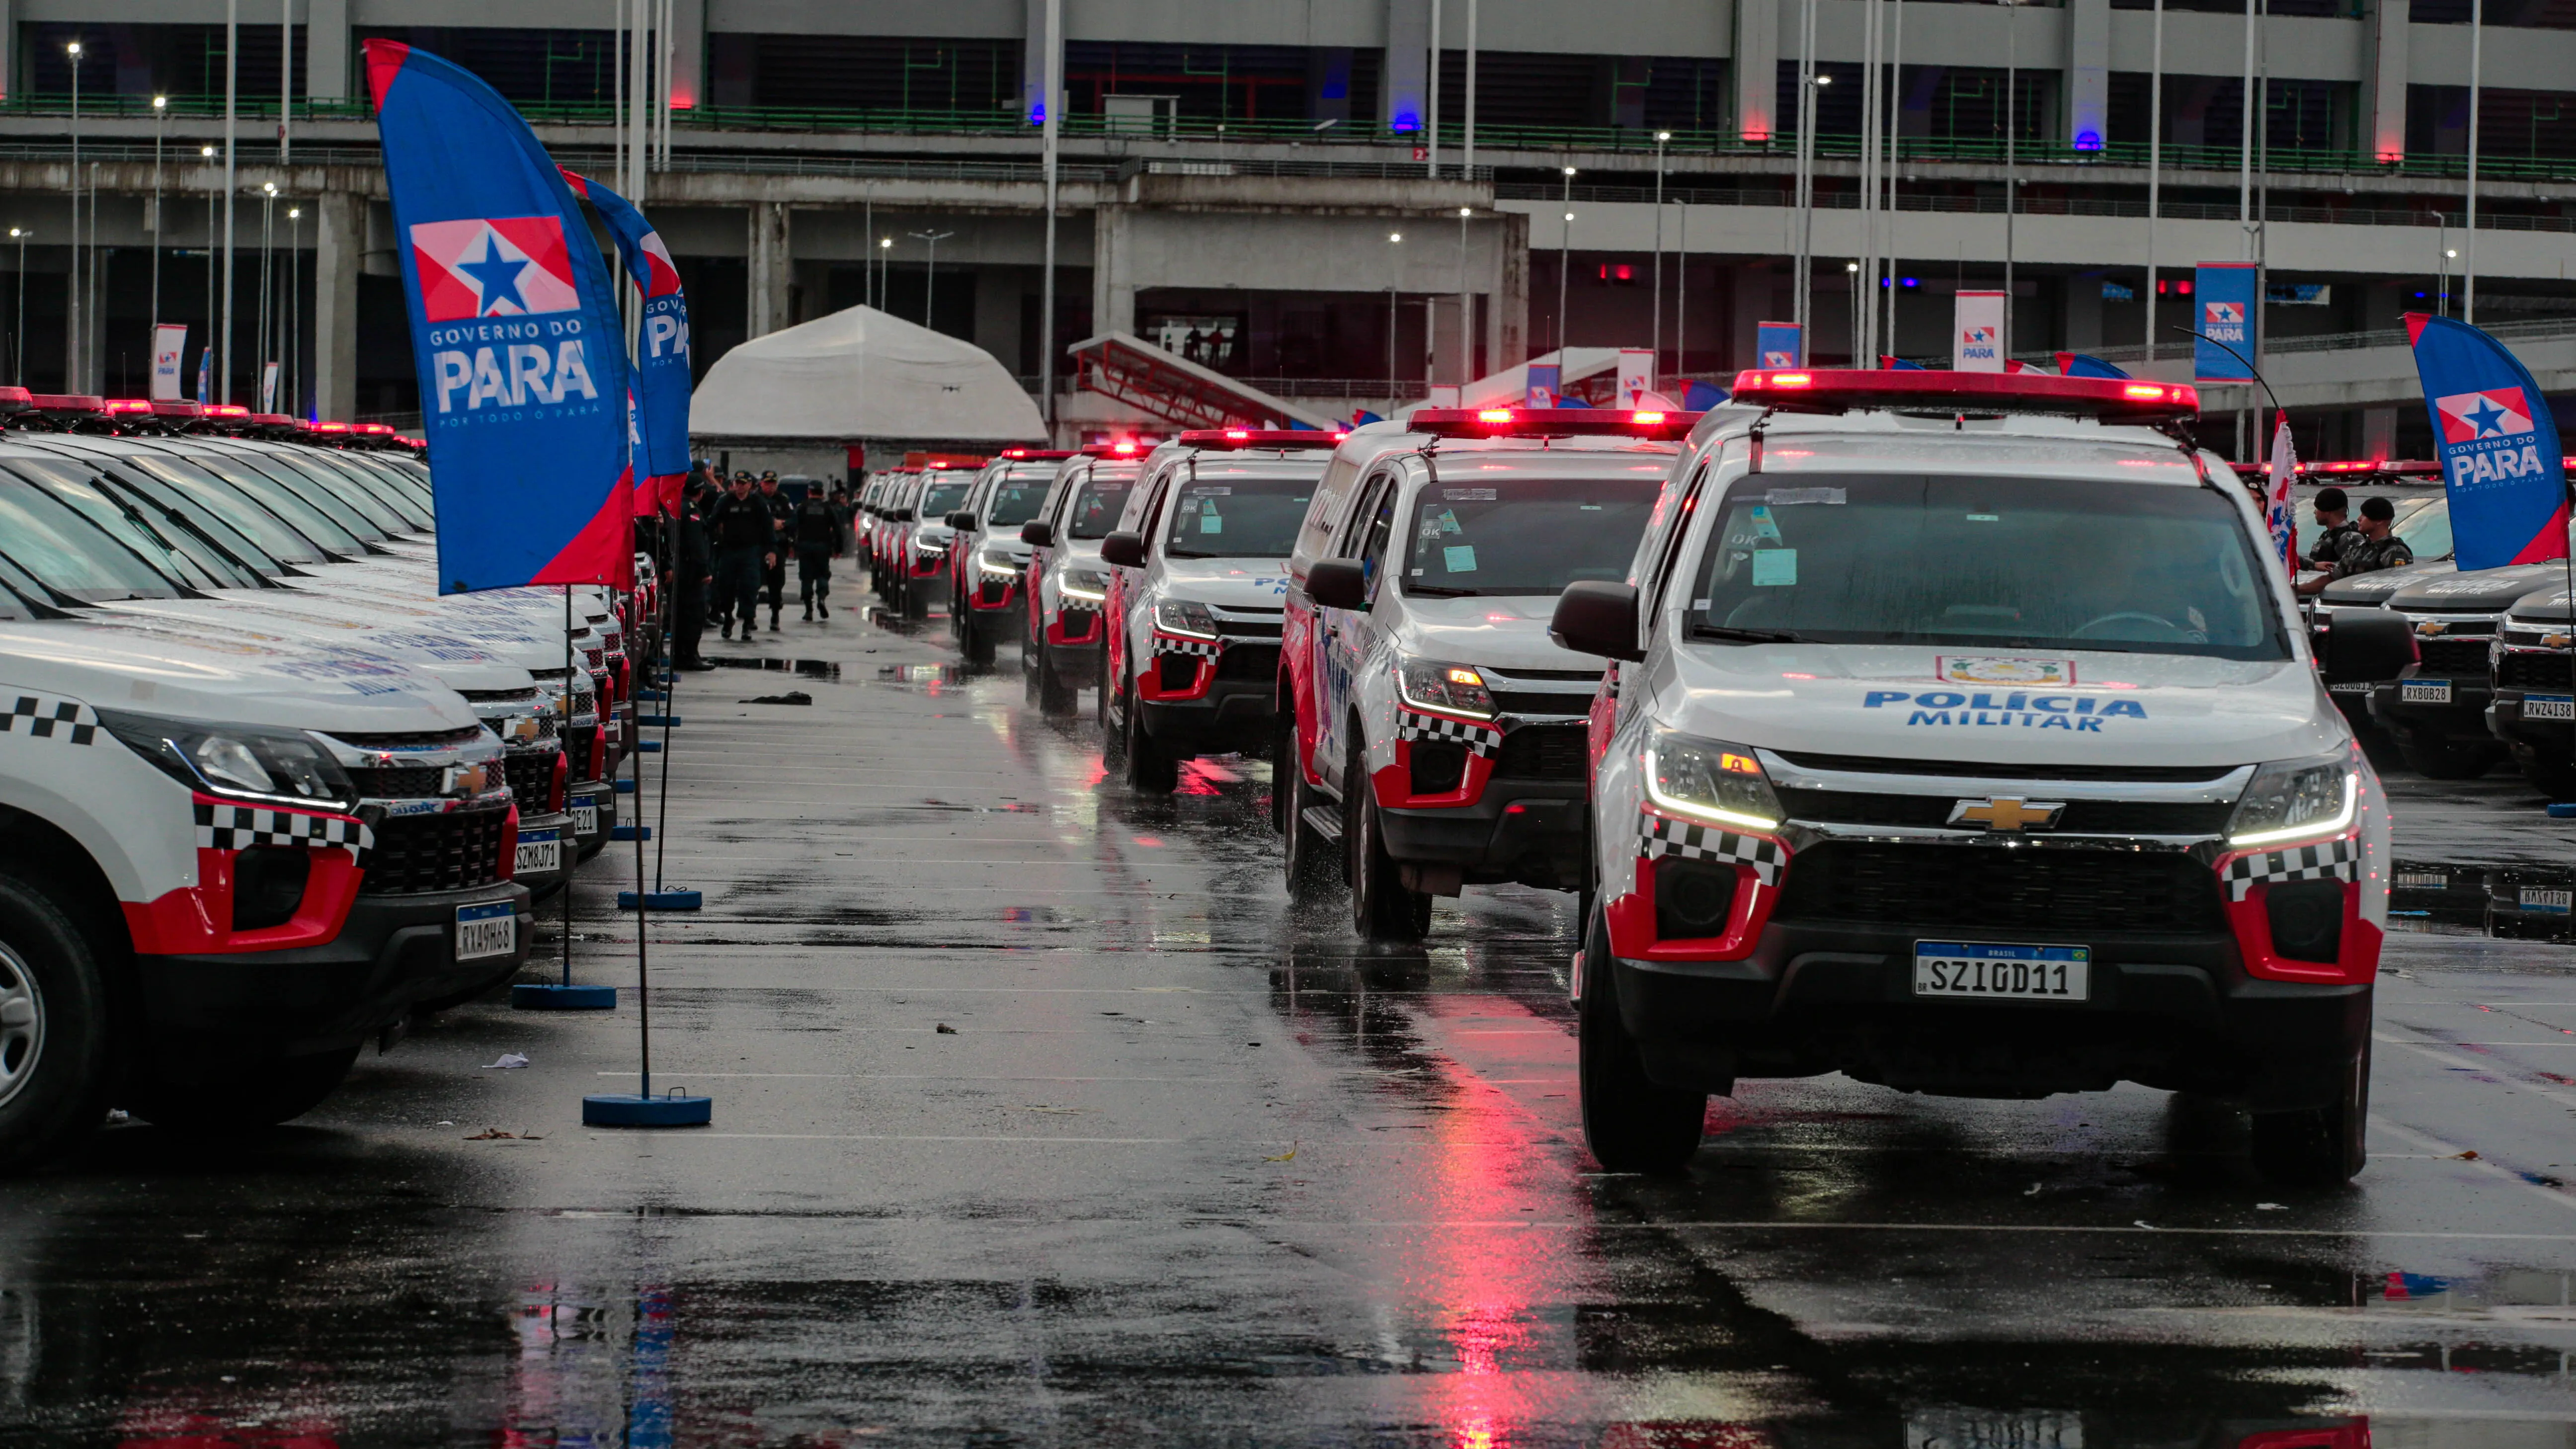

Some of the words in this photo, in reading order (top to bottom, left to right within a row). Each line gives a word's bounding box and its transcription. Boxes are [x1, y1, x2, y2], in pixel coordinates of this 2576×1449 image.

[1416, 150, 1424, 159] 2
[430, 323, 539, 346] GOVERNO
[550, 319, 581, 336] DO
[439, 417, 468, 428] POR
[479, 411, 522, 423] TODO
[2448, 439, 2510, 454] GOVERNO
[2516, 435, 2535, 445] DO
[1731, 534, 1759, 546] OK
[2407, 687, 2446, 700] RXB0B28
[1863, 691, 2148, 719] POLÍCIA
[1907, 711, 2105, 732] MILITAR
[463, 920, 509, 954] RXA9H68
[1918, 983, 1927, 992] BR
